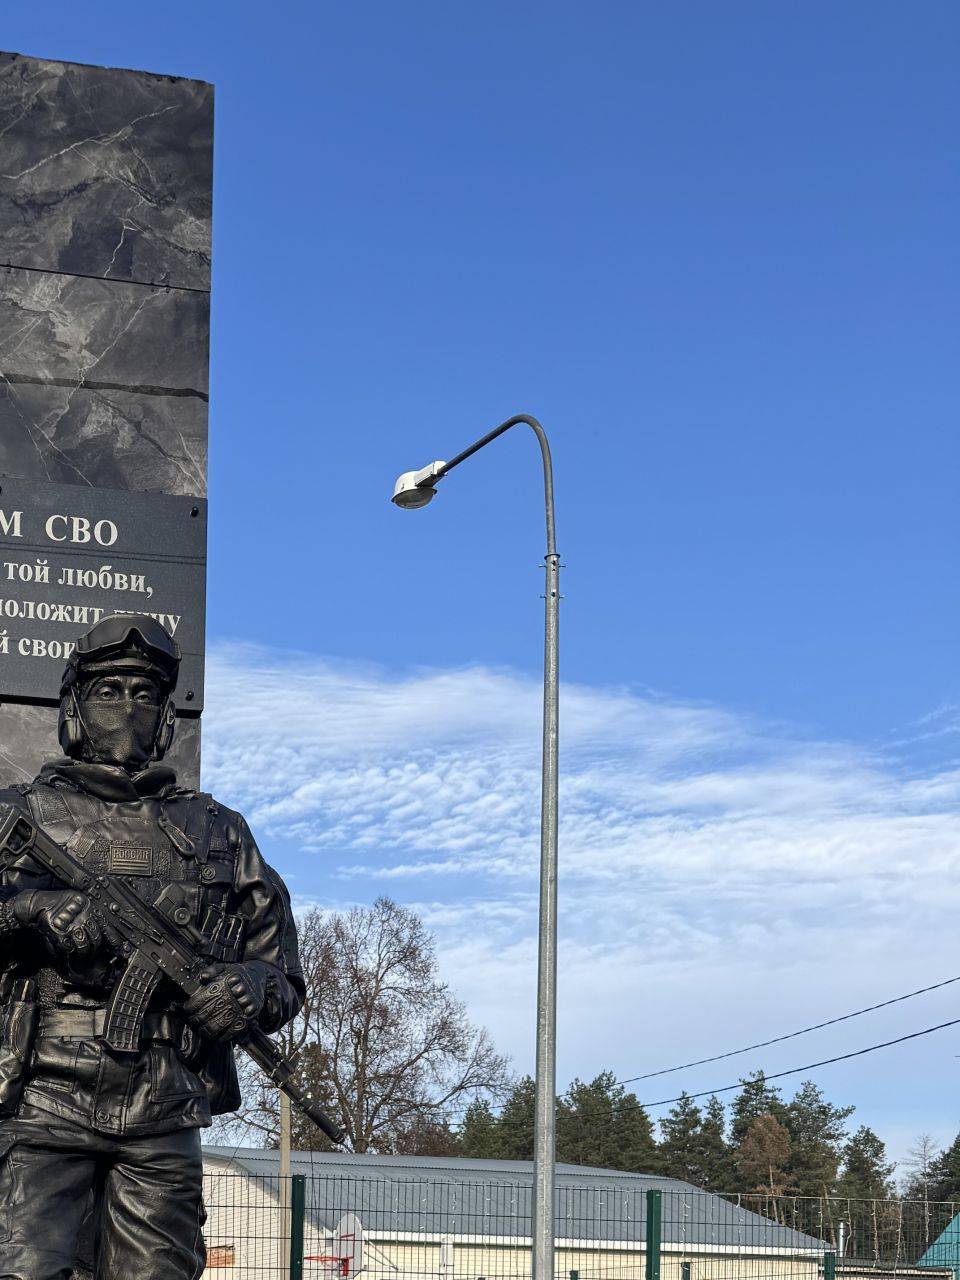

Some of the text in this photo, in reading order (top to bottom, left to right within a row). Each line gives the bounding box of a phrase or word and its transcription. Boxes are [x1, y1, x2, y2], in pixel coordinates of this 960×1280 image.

[44, 514, 119, 547] СВО
[3, 558, 51, 584] той
[57, 565, 154, 599] любви,
[17, 636, 77, 660] свои
[113, 849, 149, 860] РОССИЯ
